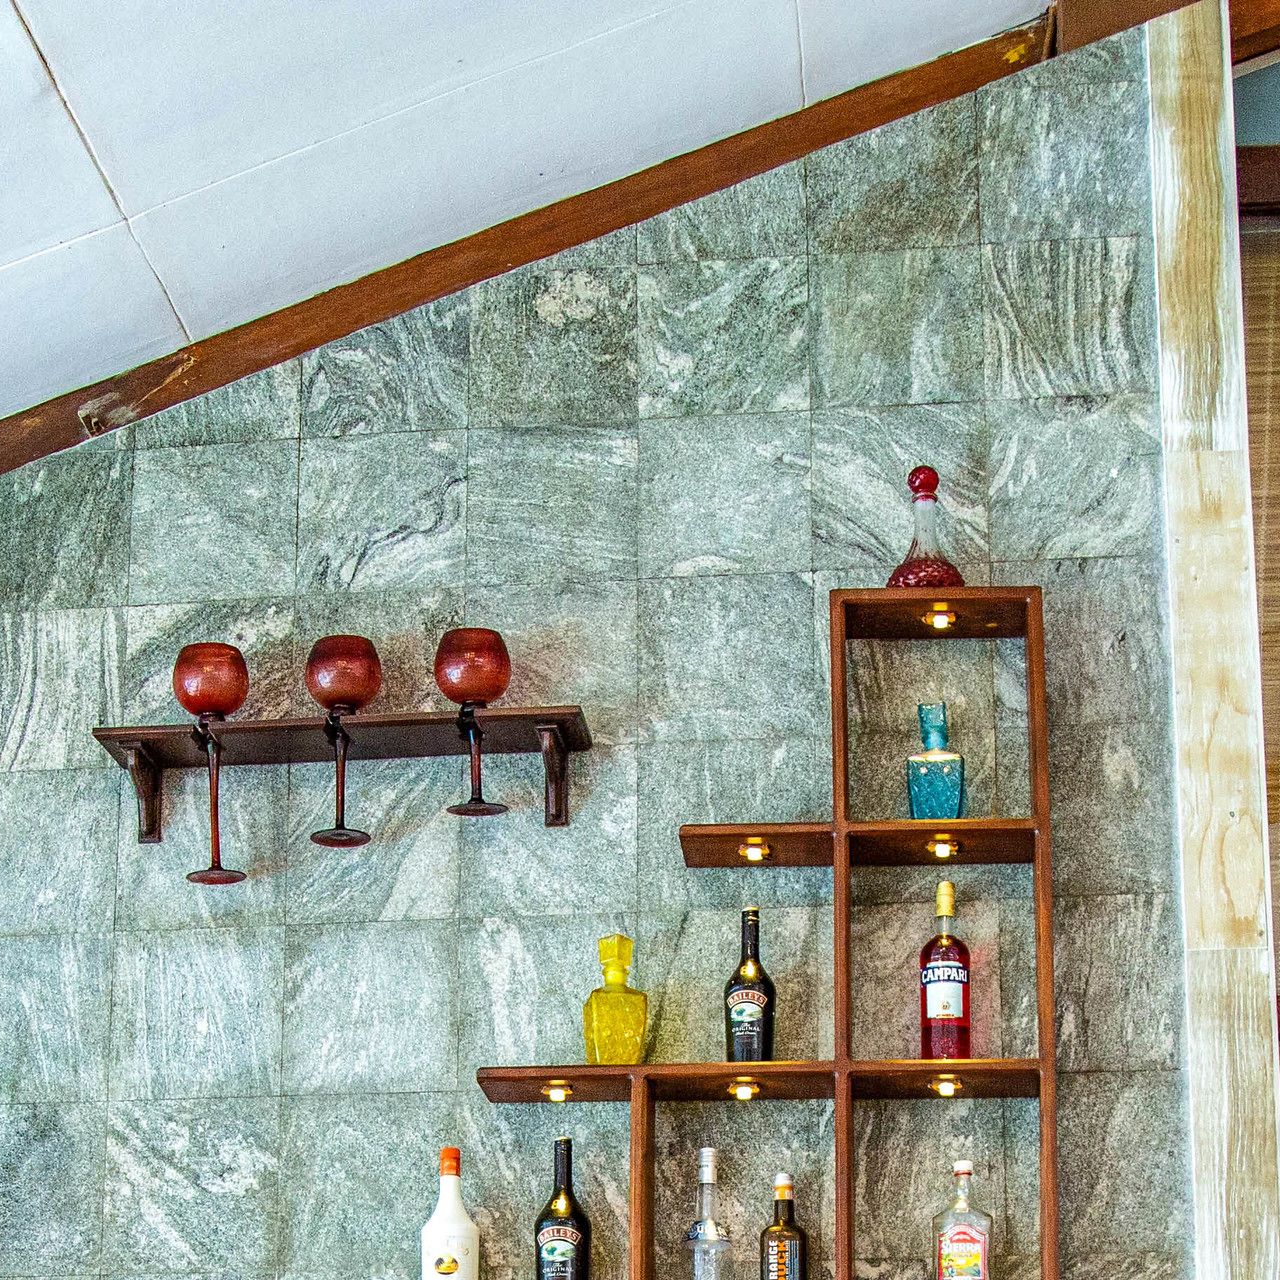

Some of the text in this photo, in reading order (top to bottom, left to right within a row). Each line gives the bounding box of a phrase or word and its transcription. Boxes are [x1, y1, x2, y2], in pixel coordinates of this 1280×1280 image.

[922, 967, 968, 984] CAMPARI
[728, 991, 765, 1004] BAILEYS
[539, 1228, 578, 1240] BAILEYS
[941, 1241, 981, 1255] SIERRA
